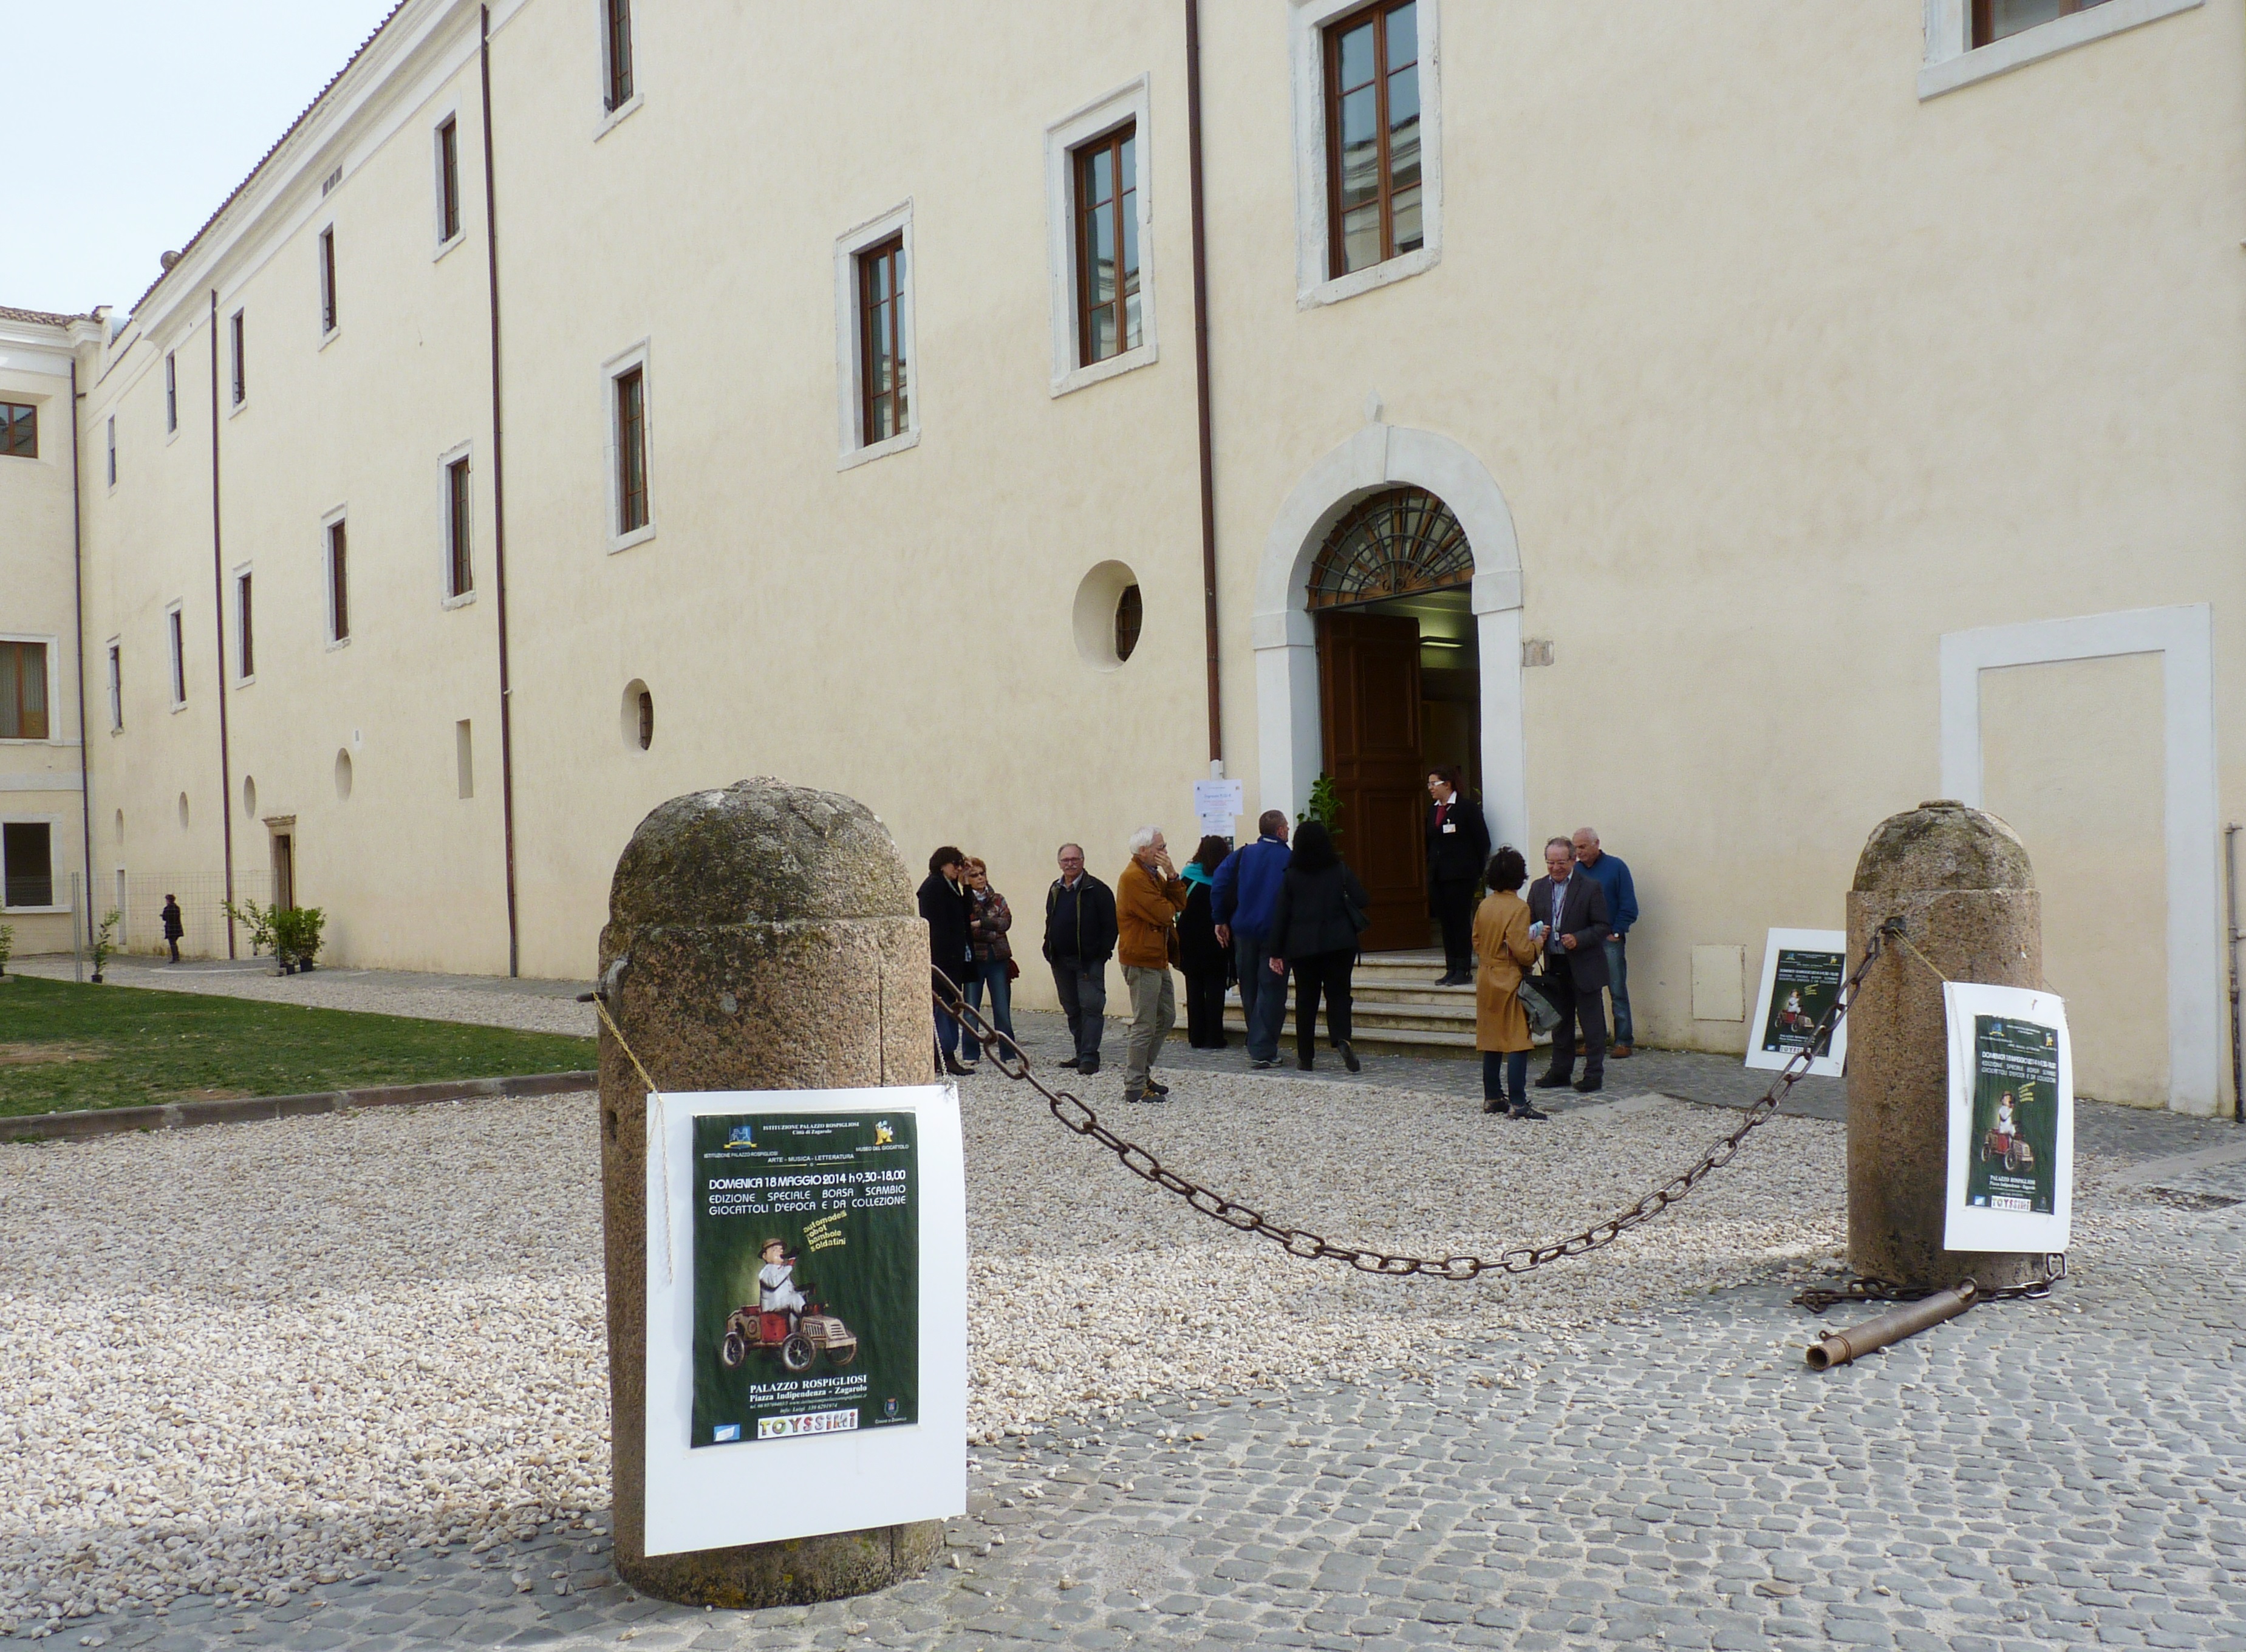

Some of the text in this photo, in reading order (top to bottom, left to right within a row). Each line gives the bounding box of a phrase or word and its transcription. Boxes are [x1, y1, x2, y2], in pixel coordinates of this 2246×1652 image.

[709, 1178, 763, 1190] DOMENICA
[765, 1176, 777, 1187] 18
[777, 1175, 822, 1187] MAGGIO
[822, 1173, 847, 1185] 2014
[849, 1173, 855, 1183] h
[709, 1184, 906, 1204] EDIZIONE SPECIALE BORSA SCAMBIO
[709, 1195, 906, 1215] GIOCATTOLI D'EPOCA E DA COLLEZIONE
[803, 1209, 847, 1233] automodelli
[805, 1224, 828, 1238] robot
[808, 1229, 842, 1246] bambole
[810, 1237, 846, 1252] soldatini
[750, 1374, 867, 1394] PALAZZO ROSPIGLIOSI
[750, 1394, 774, 1402] Piazza
[777, 1390, 826, 1400] Indipendenza
[835, 1384, 867, 1395] Zagarolo
